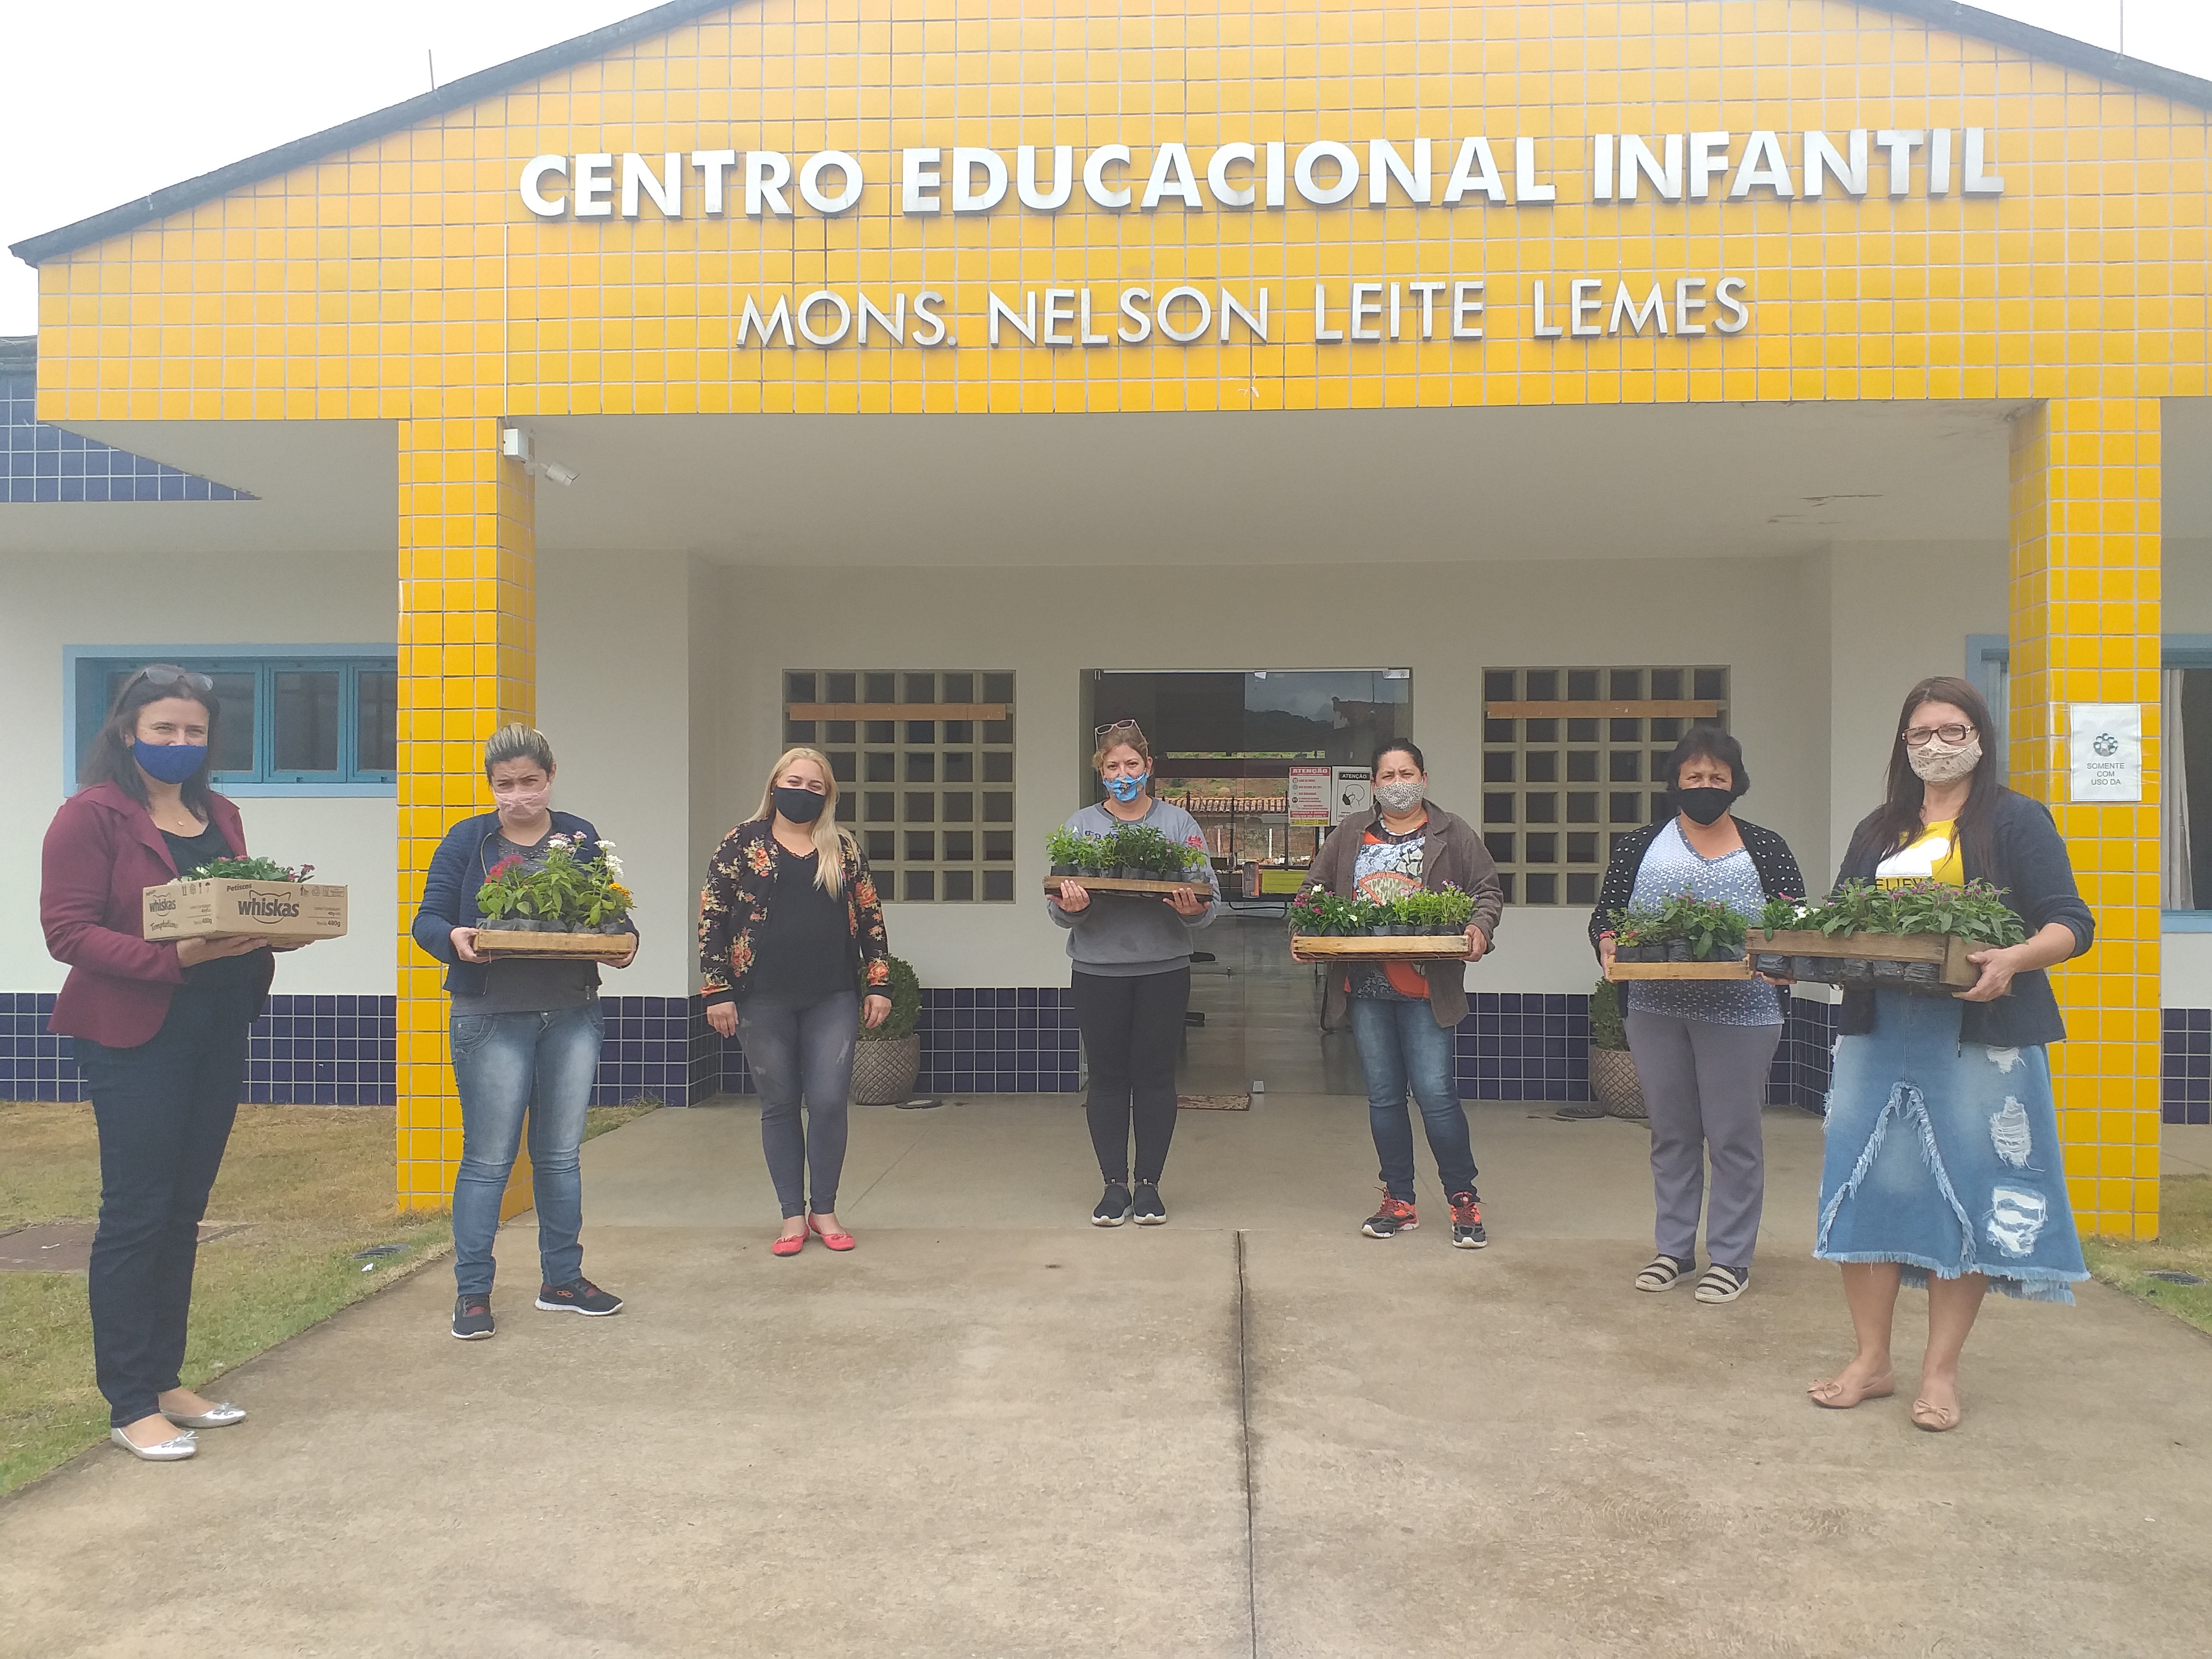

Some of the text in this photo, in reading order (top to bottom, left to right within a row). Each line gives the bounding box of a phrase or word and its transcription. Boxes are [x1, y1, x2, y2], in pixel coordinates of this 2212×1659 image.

[519, 127, 2004, 219] CENTRO EDUCACIONAL INFANTIL
[736, 276, 1749, 347] MONS. NELSON LEITE LEMES
[227, 884, 252, 892] Petiscos
[150, 899, 176, 912] whiskas
[238, 898, 300, 917] whiskas
